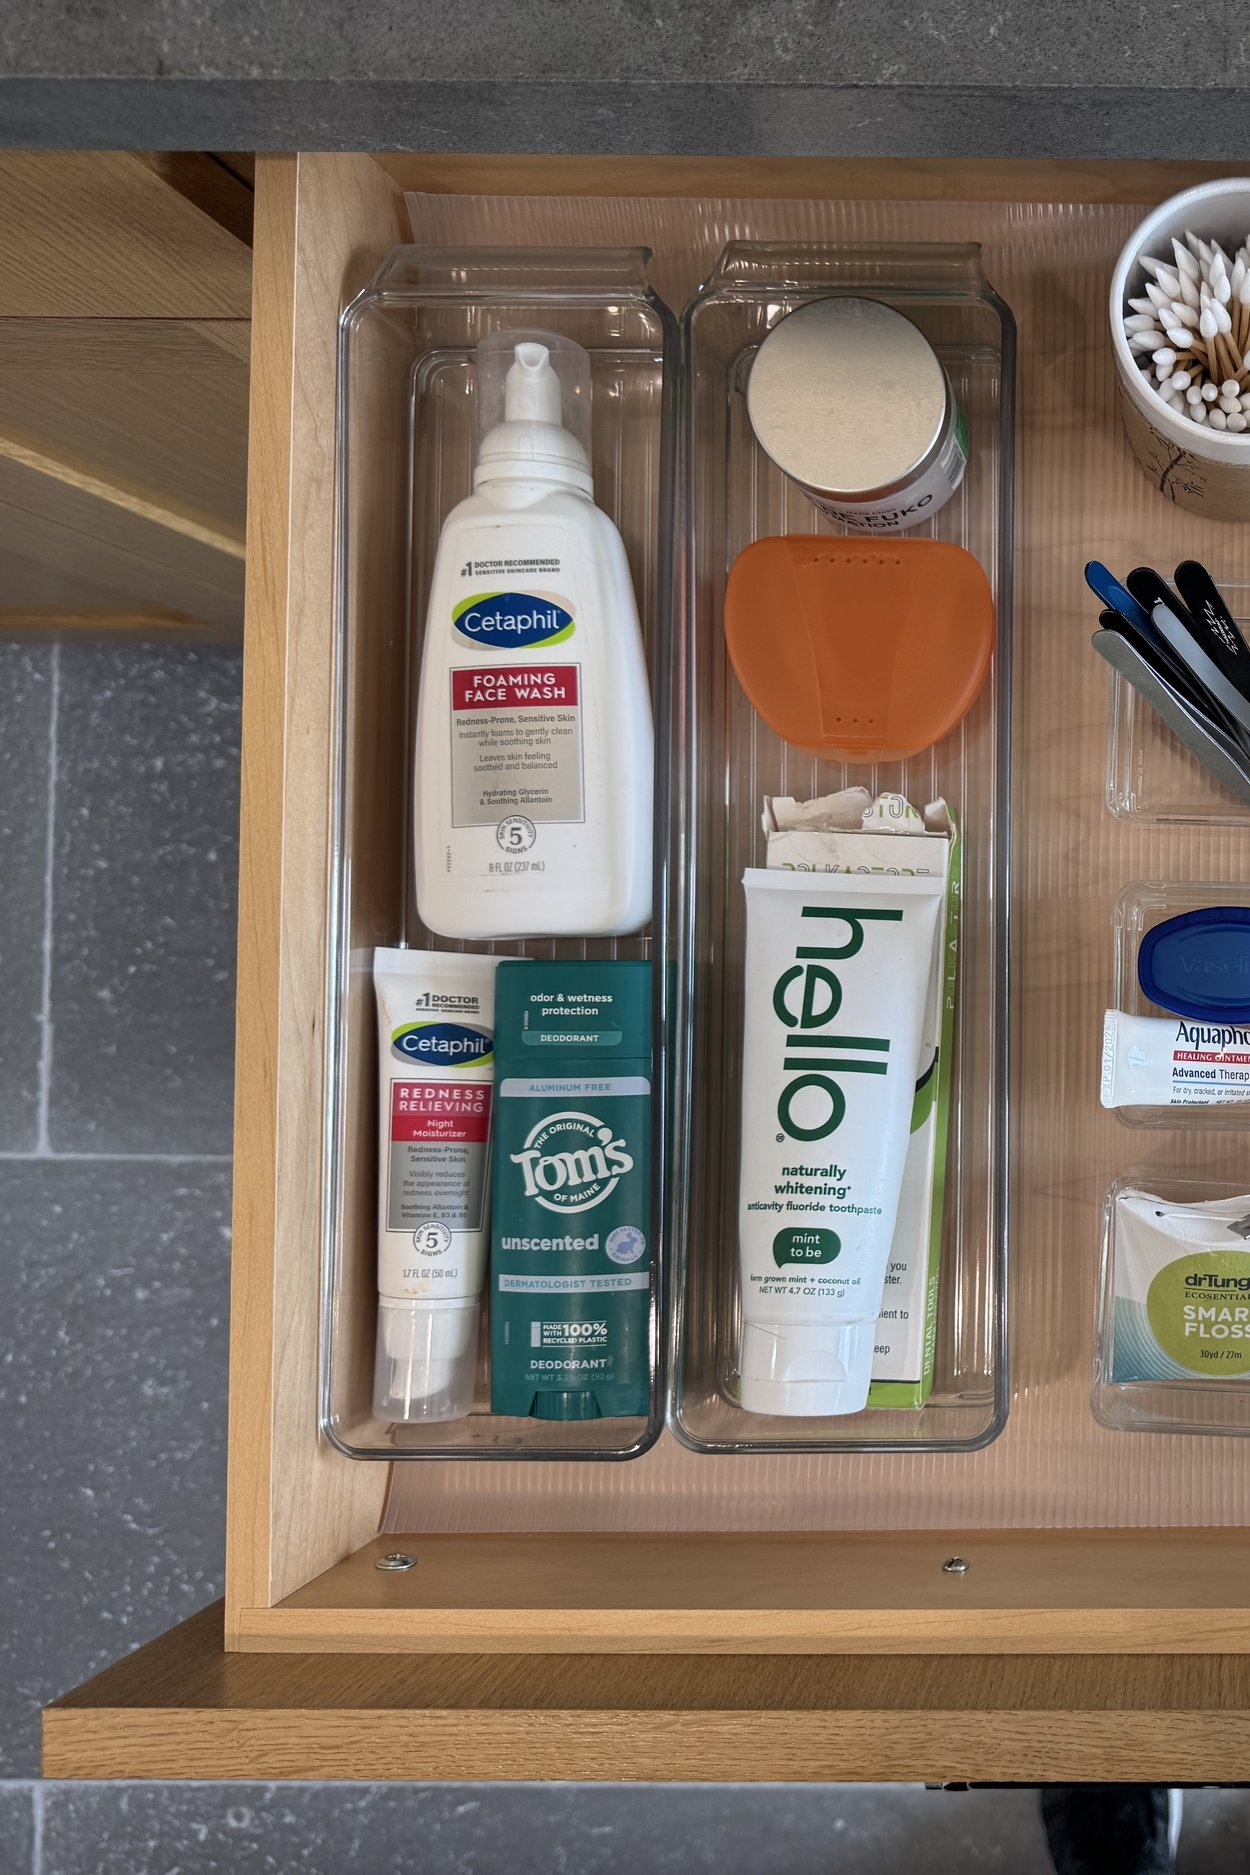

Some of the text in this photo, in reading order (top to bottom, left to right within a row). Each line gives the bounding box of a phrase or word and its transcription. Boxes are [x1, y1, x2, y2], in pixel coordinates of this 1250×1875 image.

[865, 494, 932, 522] FUKO
[461, 562, 472, 576] #1
[465, 610, 559, 633] Cetaphil
[473, 673, 555, 687] FOAMING
[465, 687, 565, 702] FACE WASH
[456, 717, 517, 726] Redness-Prone,
[519, 715, 555, 723] Sensitive
[516, 727, 573, 737] to gently clean
[500, 738, 533, 747] soothing
[525, 752, 551, 761] feeling
[474, 761, 558, 771] soothed and balanced
[509, 827, 523, 845] 5
[416, 993, 430, 1007] #1
[432, 995, 478, 1004] DOCTOR
[531, 994, 613, 1002] odor & wetness
[542, 1006, 598, 1016] protection
[772, 906, 904, 1142] hello
[403, 1035, 485, 1055] Cetaphil
[1177, 1052, 1212, 1062] HEALING
[1173, 1067, 1216, 1078] Advanced
[401, 1088, 484, 1099] REDNESS
[530, 1084, 581, 1092] ALUMINUM
[400, 1101, 483, 1112] RELIEVING
[428, 1120, 453, 1129] Night
[534, 1122, 595, 1148] THE ORIGINAL
[510, 1127, 633, 1196] Tom's
[782, 1165, 847, 1181] naturally
[554, 1183, 601, 1202] OF MAINE
[786, 1201, 882, 1216] fluoride toothpaste
[426, 1233, 438, 1248] 5
[502, 1234, 599, 1250] unscented
[792, 1234, 820, 1244] mint
[790, 1247, 822, 1257] to be
[890, 1262, 907, 1272] you
[504, 1278, 632, 1288] DERMATOLOGIST TESTED
[764, 1275, 850, 1285] grown mint coconut
[759, 1286, 773, 1294] NET
[927, 1276, 935, 1320] TOOLS
[563, 1323, 607, 1336] 100%
[924, 1323, 932, 1375] DENTAL
[1200, 1350, 1242, 1360] 30yd 27m
[531, 1359, 607, 1369] DEODORANT
